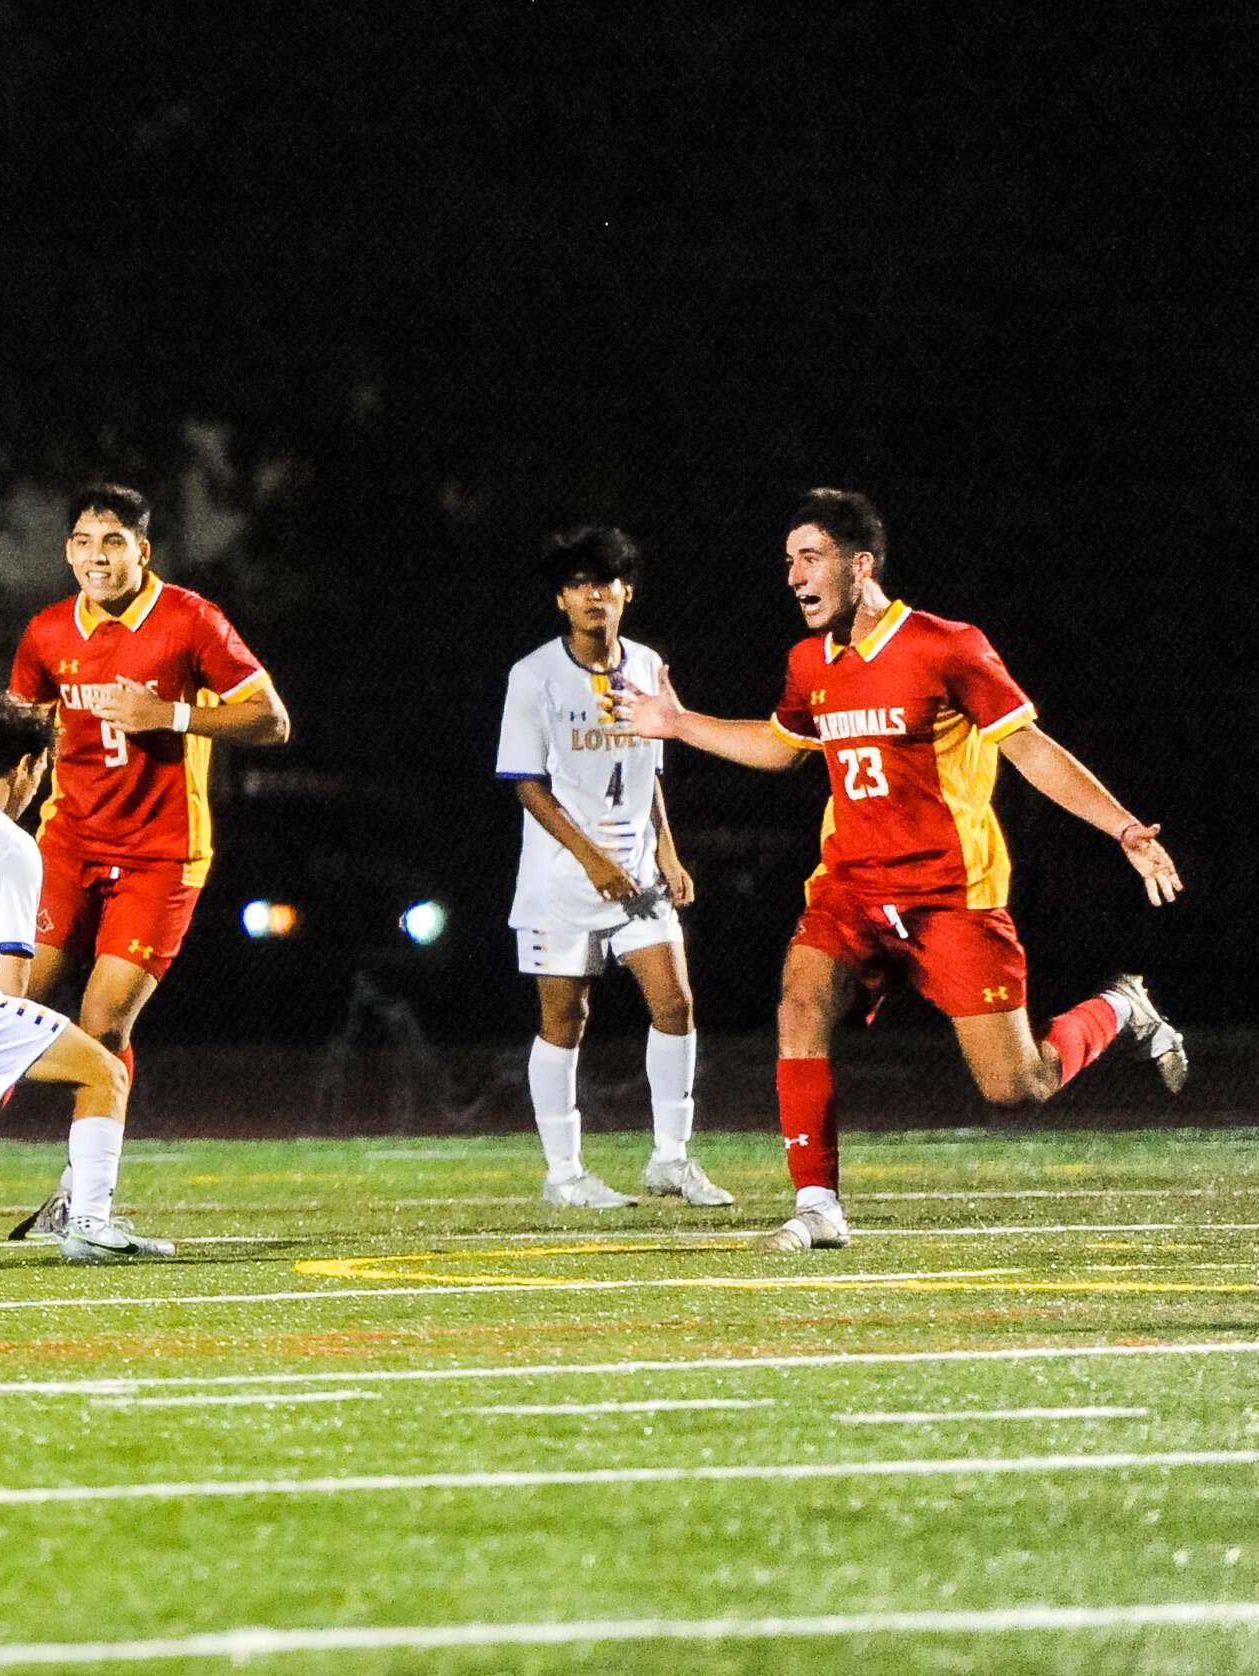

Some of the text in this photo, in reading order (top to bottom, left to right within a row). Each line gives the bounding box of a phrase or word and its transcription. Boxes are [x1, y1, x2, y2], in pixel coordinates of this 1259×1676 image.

[101, 719, 128, 767] 9
[605, 761, 624, 806] 4
[837, 746, 889, 800] 23
